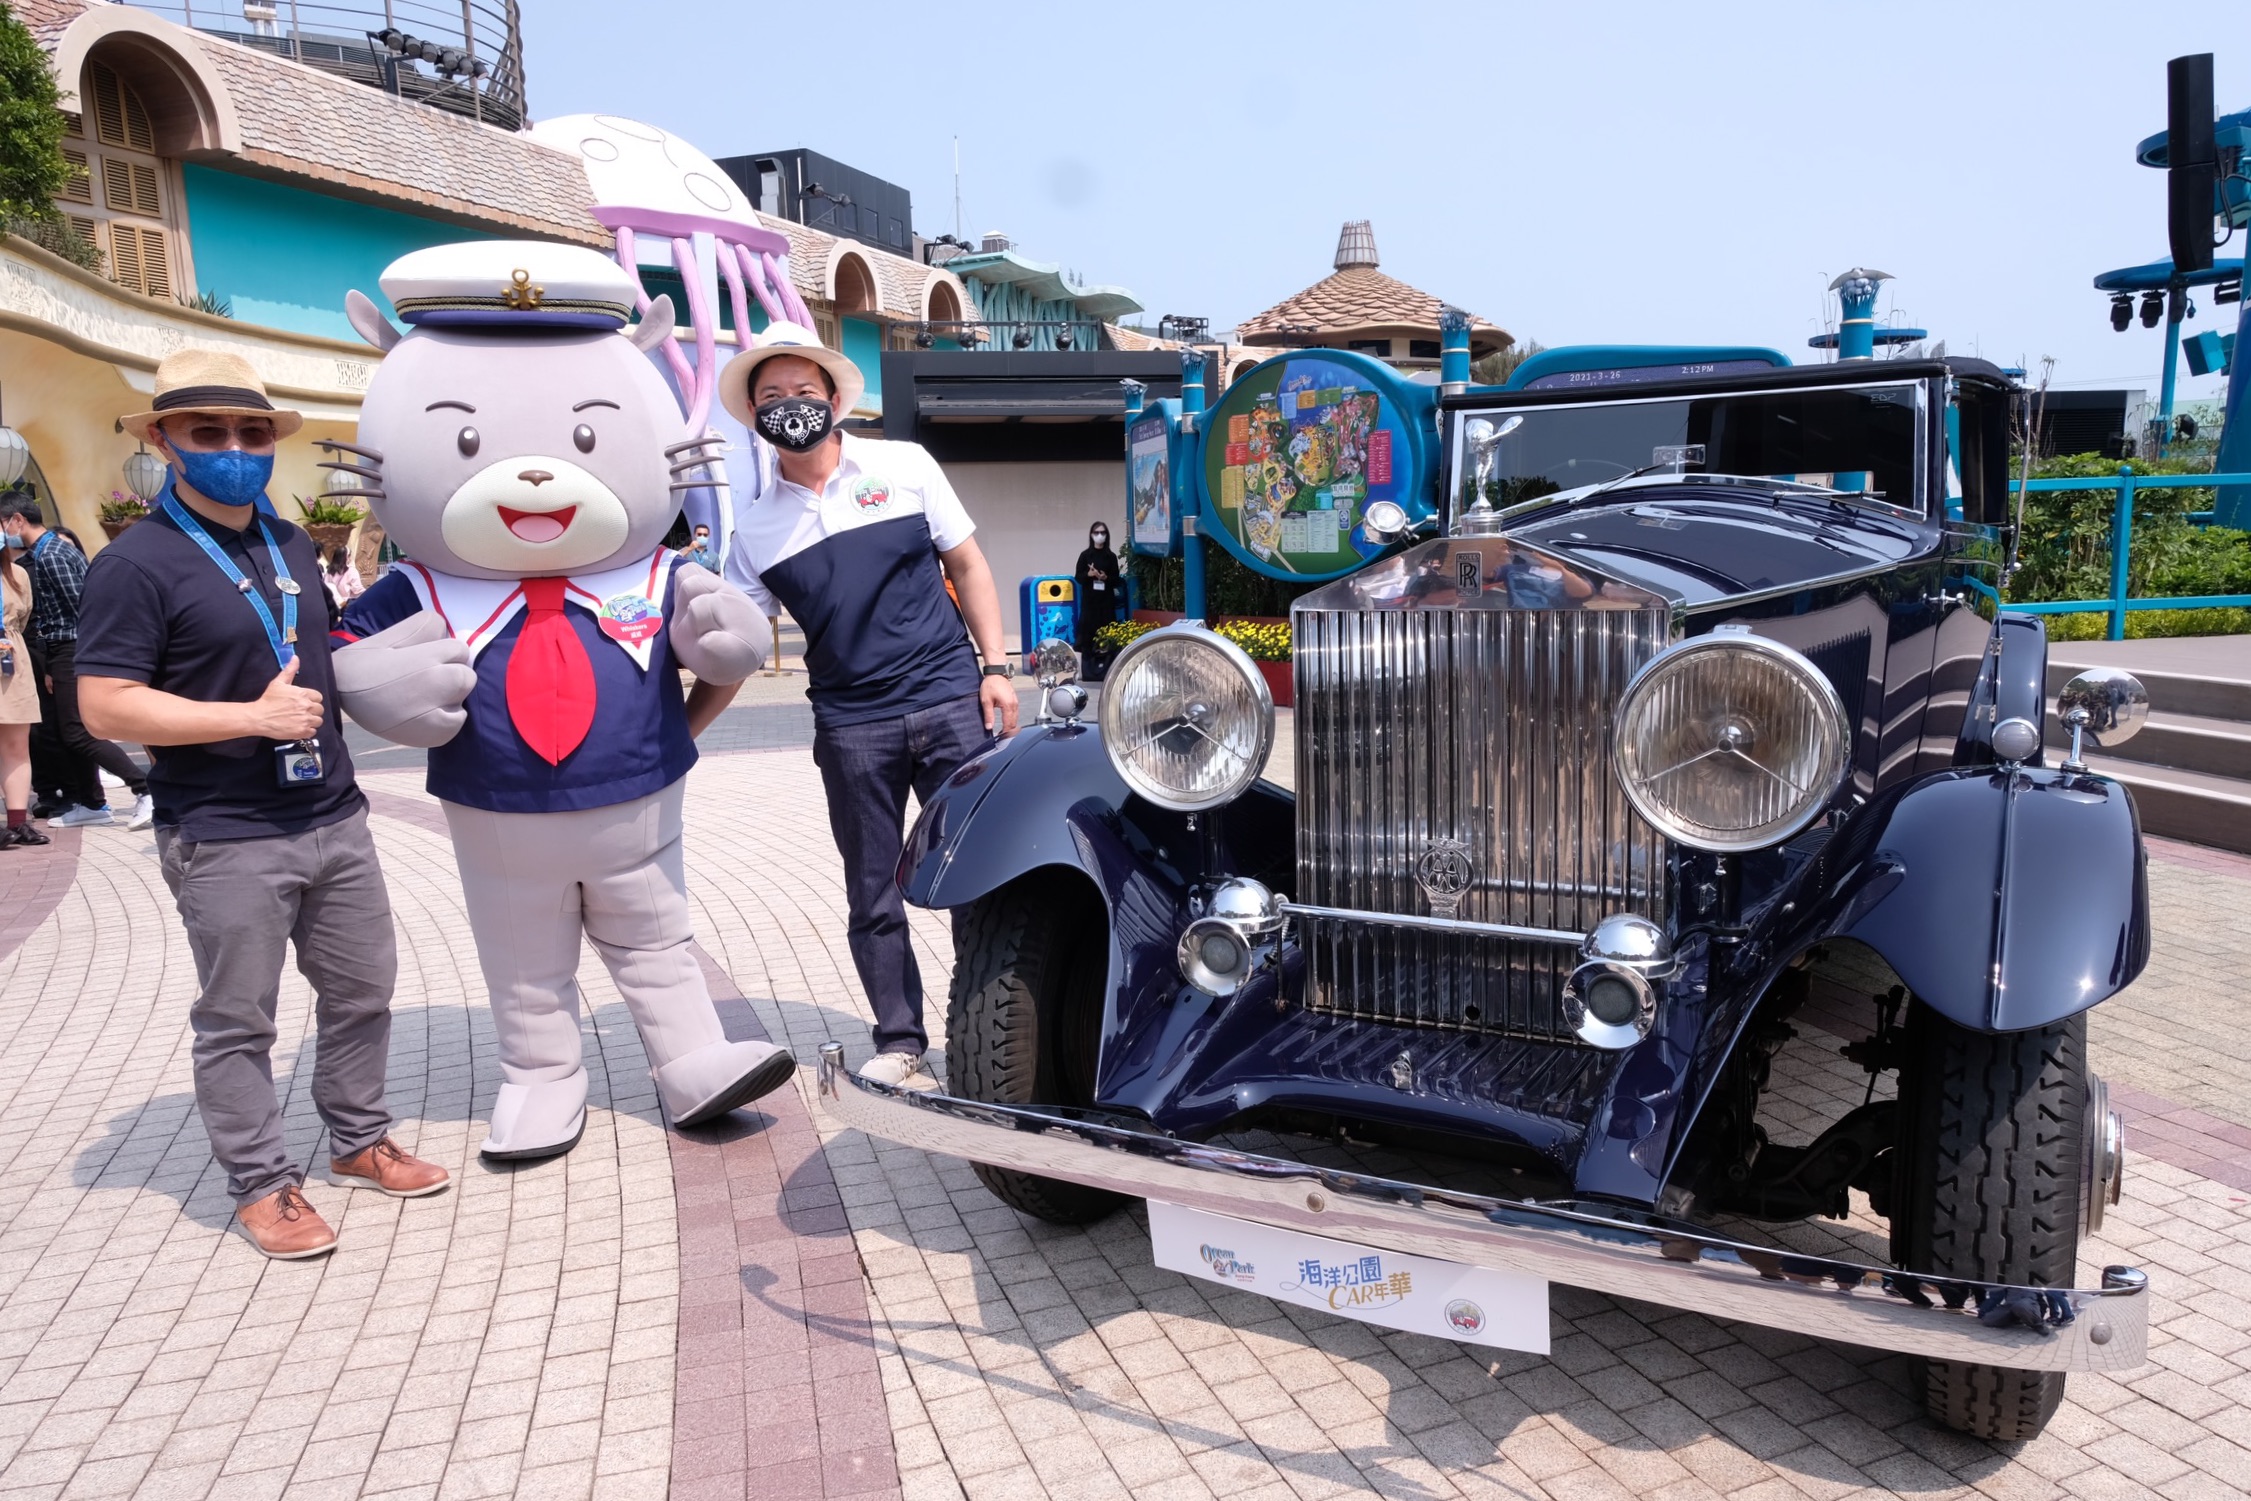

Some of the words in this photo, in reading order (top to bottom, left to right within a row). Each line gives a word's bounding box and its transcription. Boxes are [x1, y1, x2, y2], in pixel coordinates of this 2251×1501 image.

[783, 428, 807, 440] LONDON
[1458, 588, 1479, 596] ROYCE
[620, 624, 648, 633] Whiskers
[1200, 1243, 1236, 1264] Ocean
[1298, 1255, 1382, 1289] 海洋公園
[1328, 1271, 1412, 1310] CAR年華
